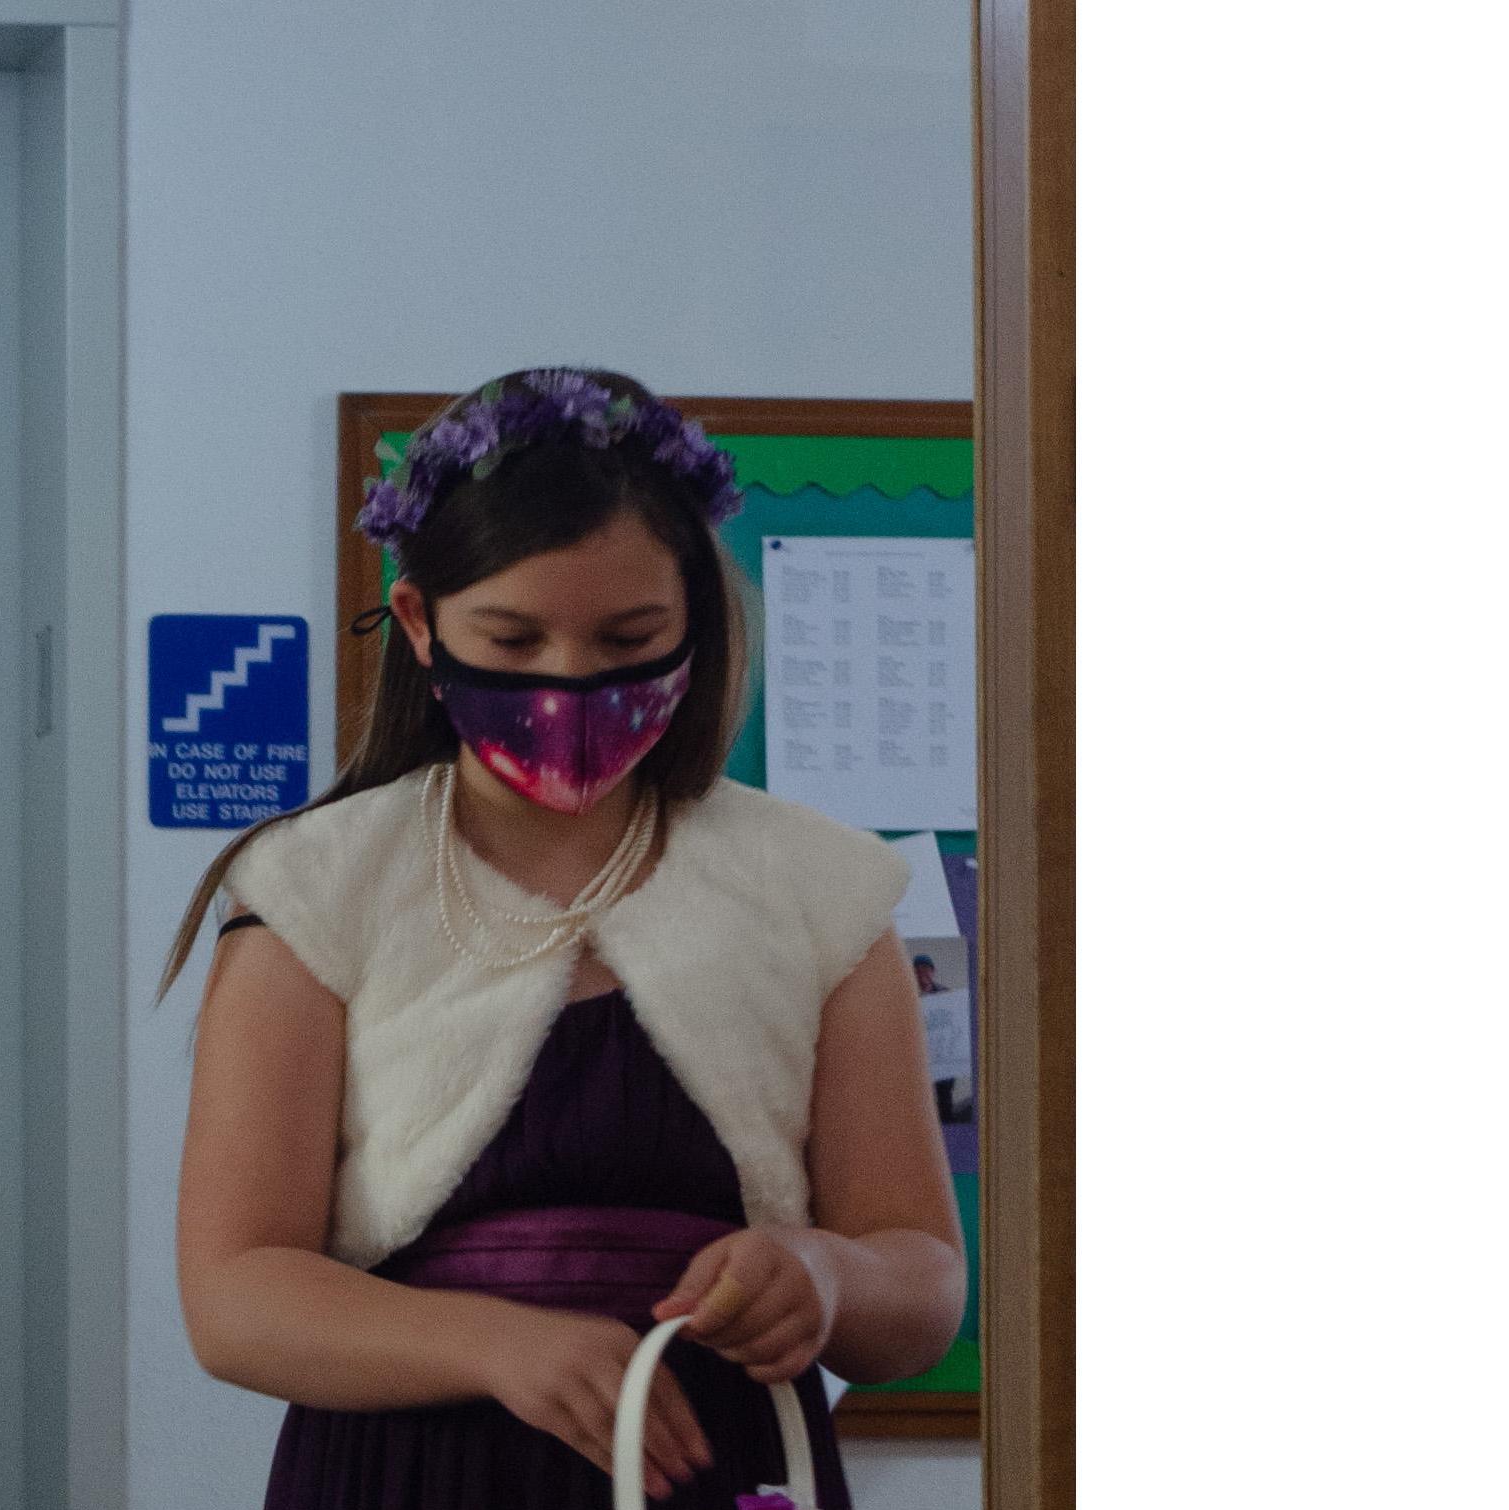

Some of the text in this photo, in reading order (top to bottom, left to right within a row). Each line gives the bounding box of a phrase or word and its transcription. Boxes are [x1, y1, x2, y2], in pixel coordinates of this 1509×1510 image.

[149, 743, 308, 761] IN CASE OF FIRE
[168, 763, 286, 781] DO NOT USE
[176, 783, 279, 800] ELEVATORS
[172, 803, 209, 820] USE
